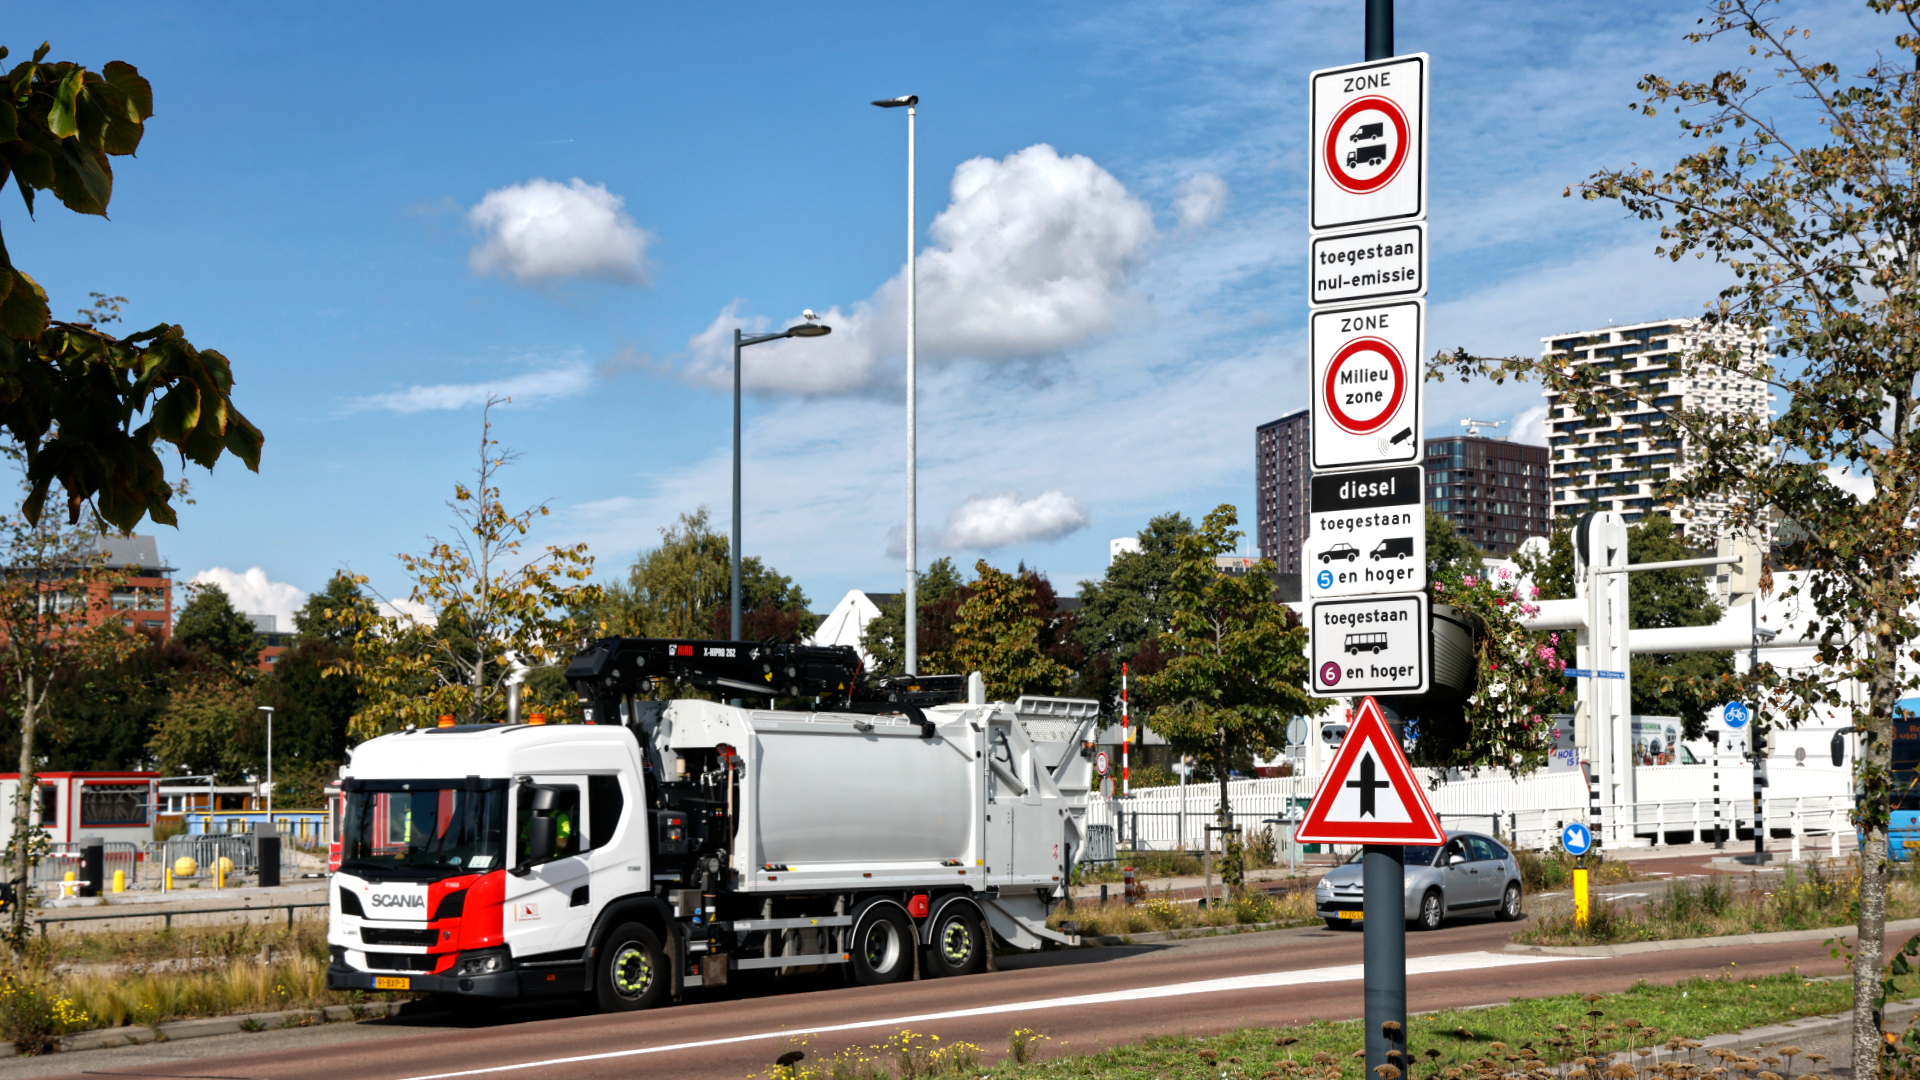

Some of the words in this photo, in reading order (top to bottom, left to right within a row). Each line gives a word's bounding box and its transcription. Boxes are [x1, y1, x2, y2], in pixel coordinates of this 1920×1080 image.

[1344, 72, 1391, 93] ZONE
[1320, 242, 1414, 266] toegestaan
[1318, 267, 1415, 291] nul-emissie
[1341, 314, 1389, 332] ZONE
[1341, 368, 1388, 385] Milieu
[1346, 391, 1383, 405] zone
[1339, 477, 1396, 499] diesel
[1320, 513, 1411, 532] toegestaan
[1321, 573, 1330, 587] 5
[1338, 571, 1357, 583] en
[1365, 567, 1414, 584] hoger
[1324, 610, 1408, 628] toegestaan
[678, 645, 693, 656] HIAB
[703, 647, 725, 657] X-HIPRO
[726, 648, 736, 658] 262
[1325, 666, 1335, 680] 6
[1346, 666, 1364, 679] en
[1370, 664, 1414, 681] hoger
[1558, 749, 1574, 760] HOE
[1567, 757, 1575, 766] IS
[371, 894, 425, 908] SCANIA
